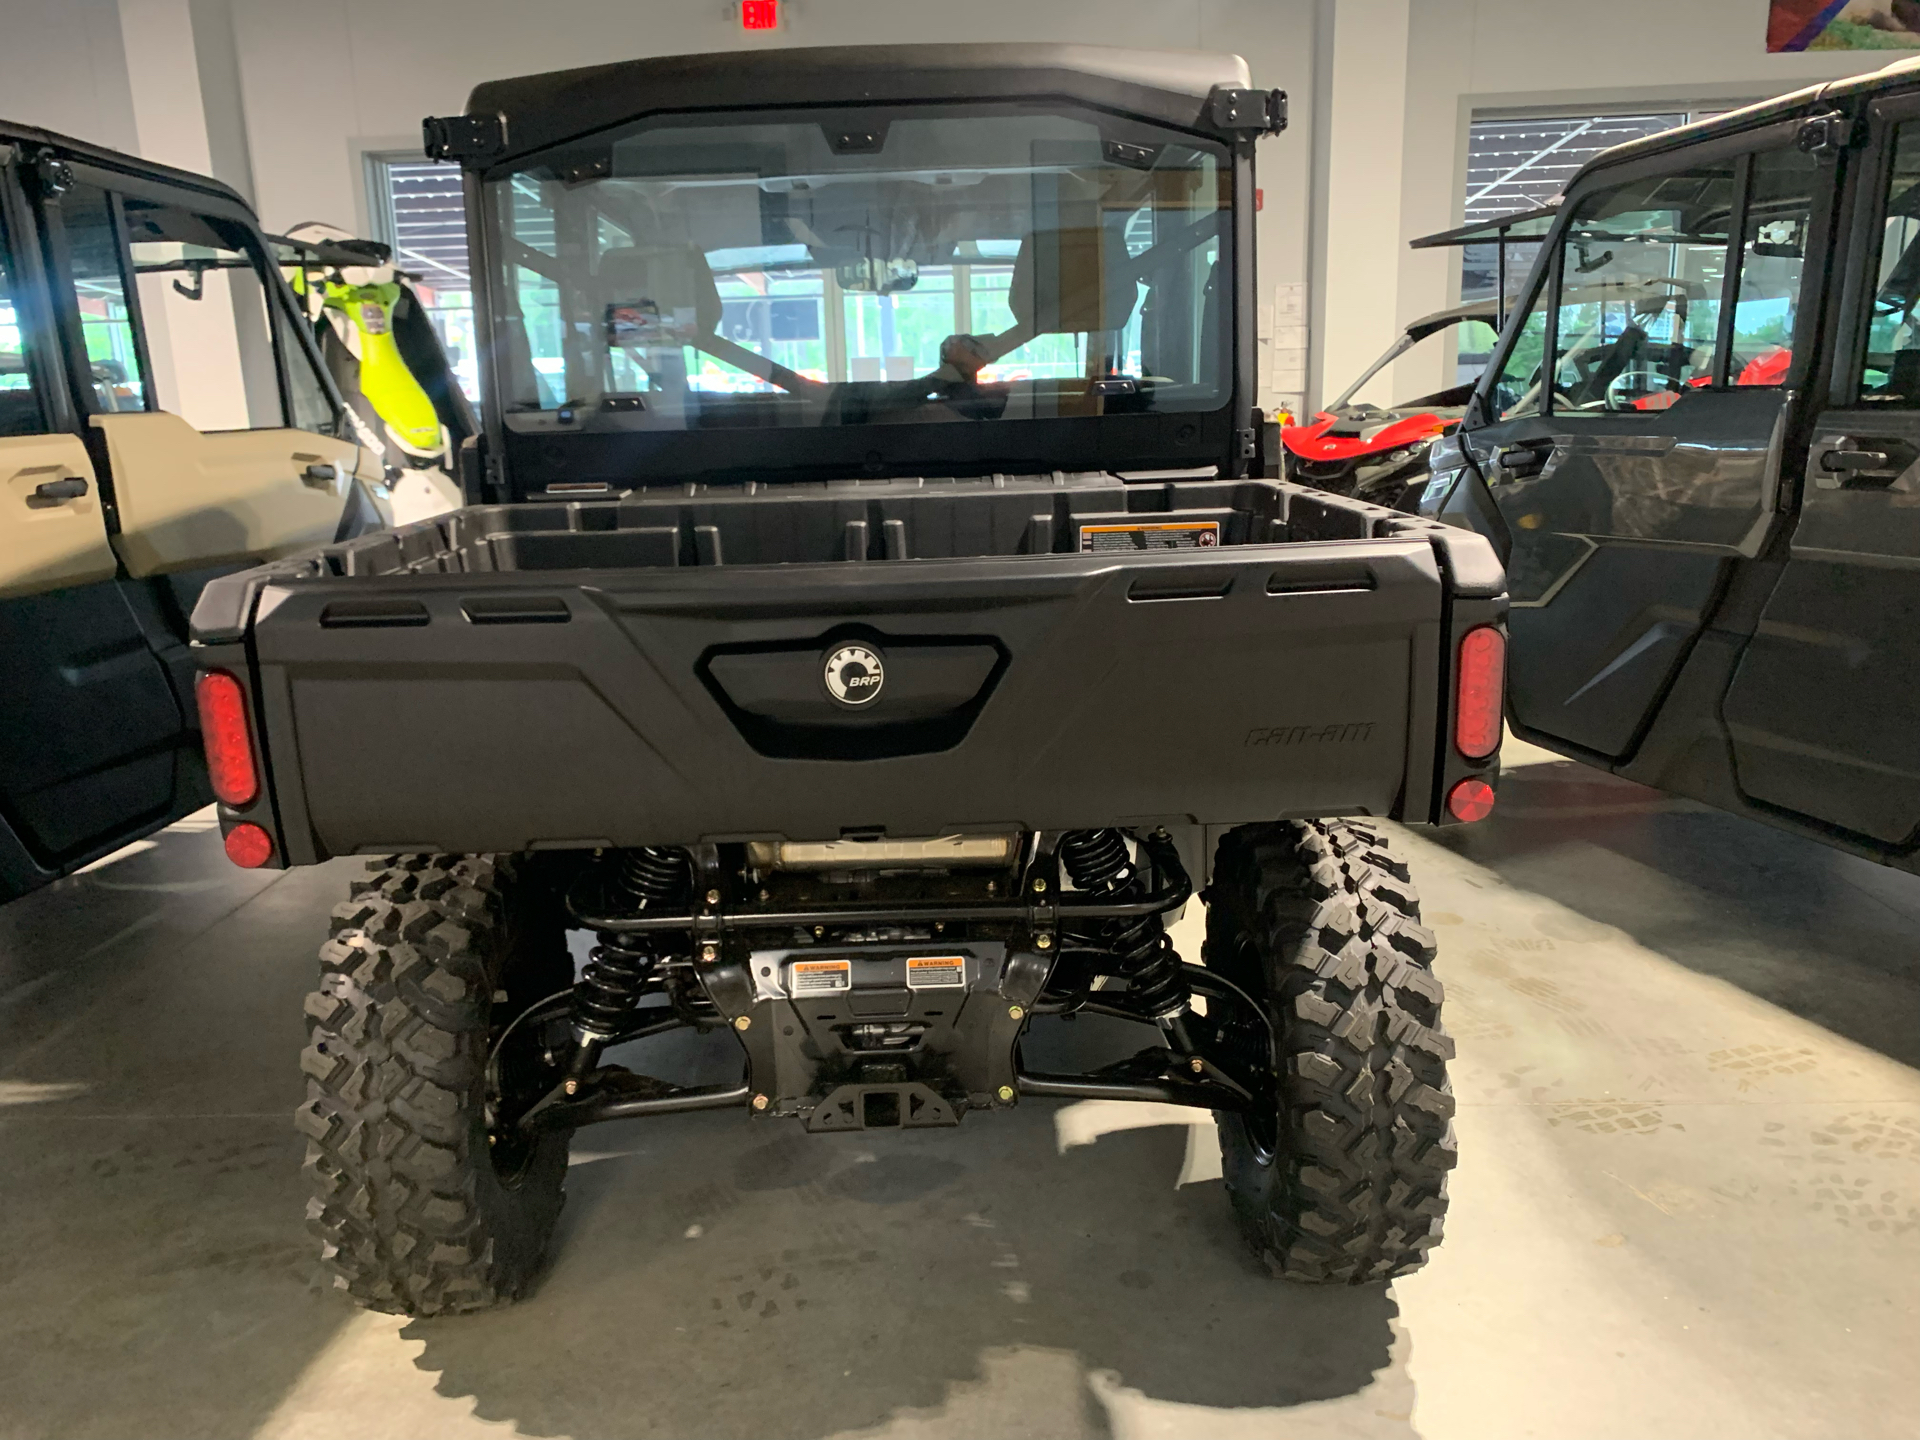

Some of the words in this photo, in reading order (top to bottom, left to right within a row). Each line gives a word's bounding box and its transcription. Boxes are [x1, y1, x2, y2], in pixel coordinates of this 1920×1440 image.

[743, 0, 778, 29] EXIT
[849, 676, 880, 687] BRP
[923, 959, 955, 967] WARNING
